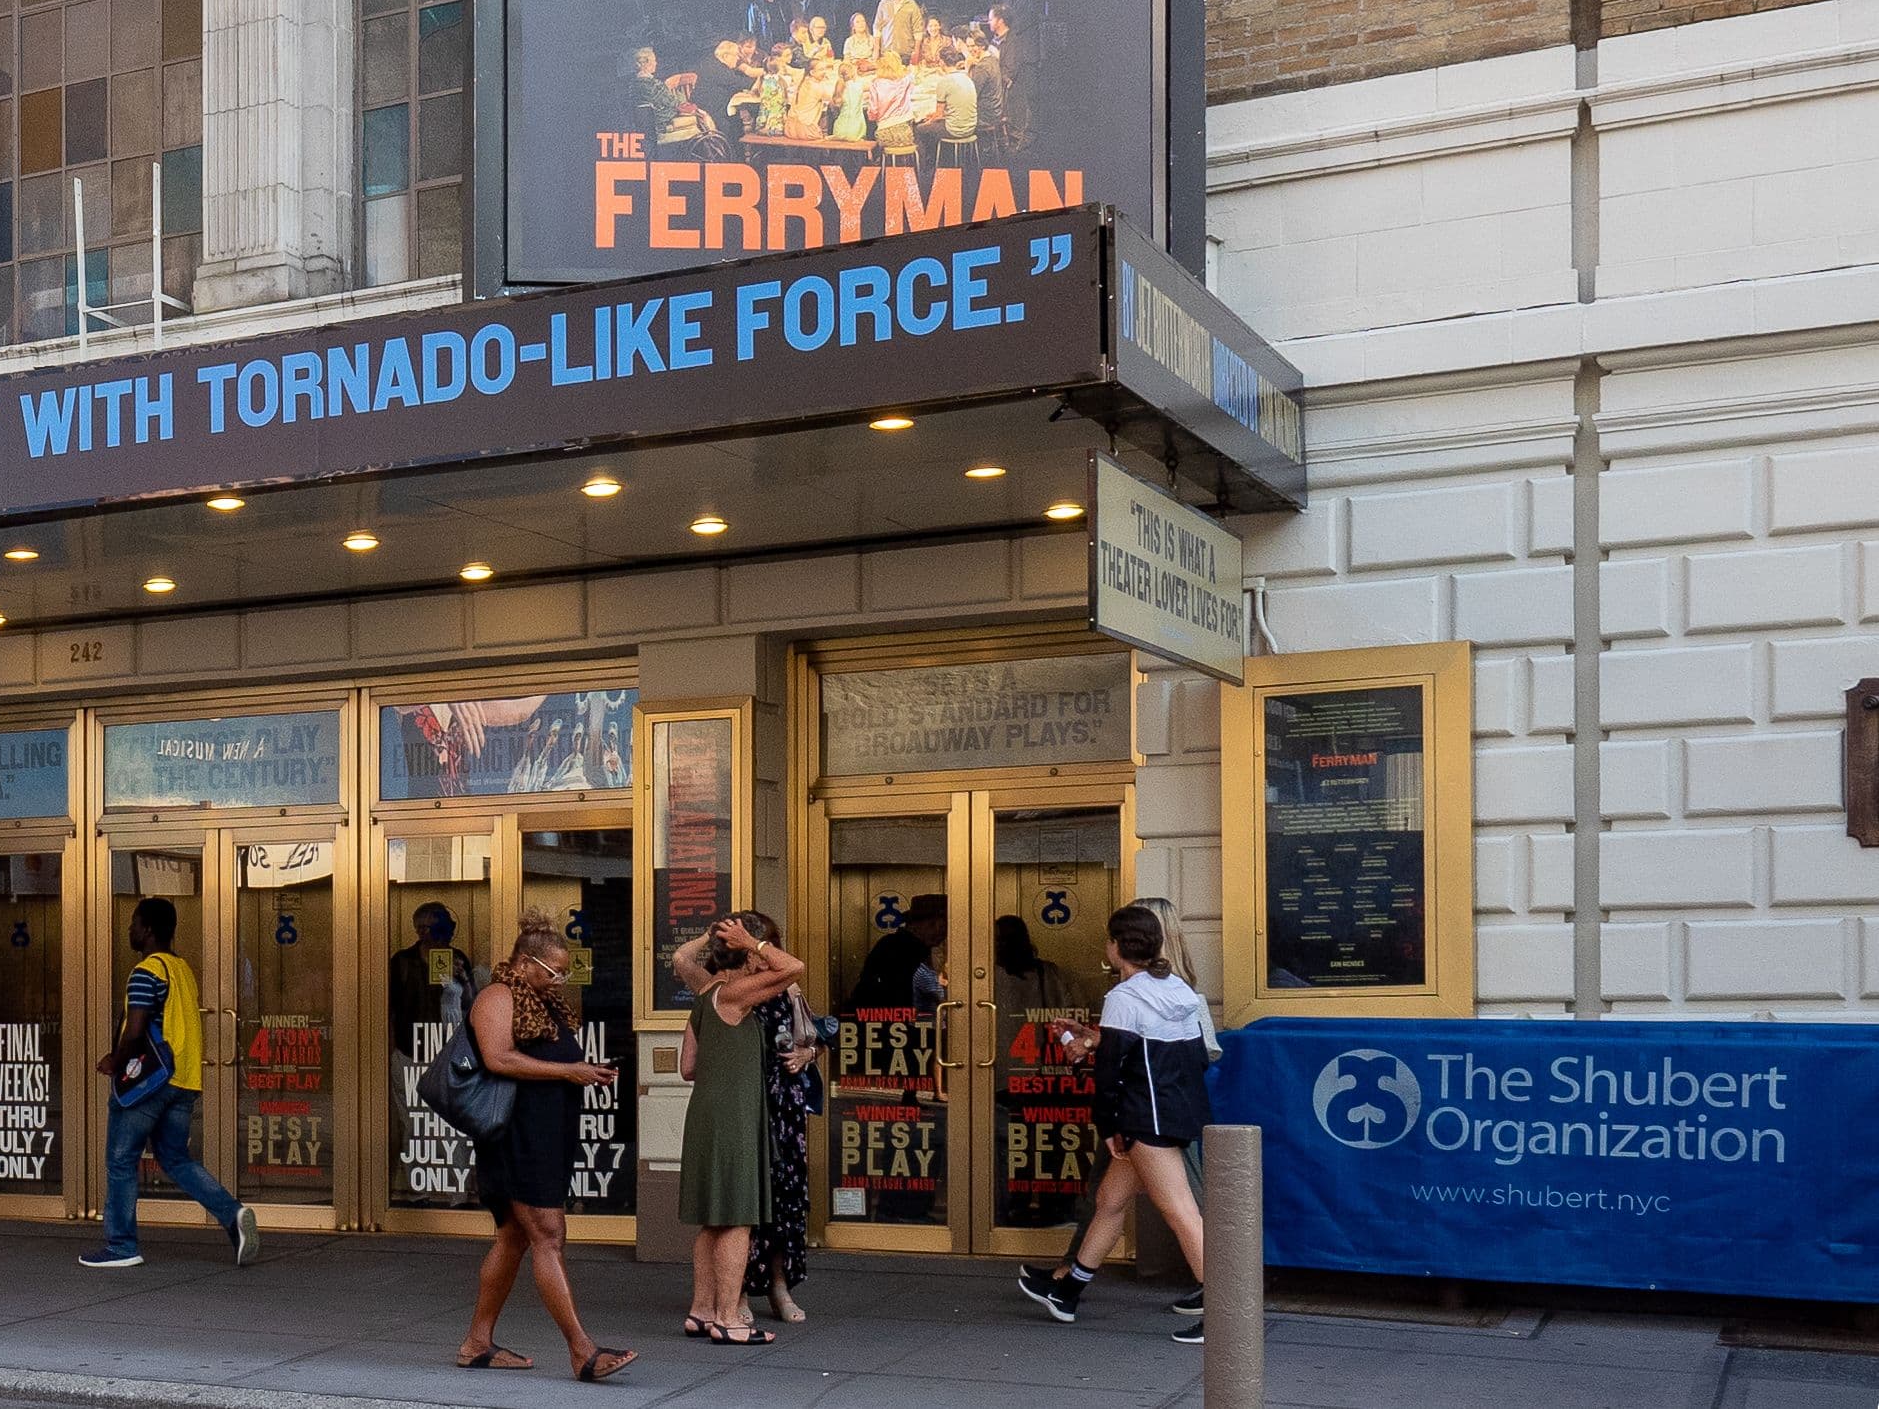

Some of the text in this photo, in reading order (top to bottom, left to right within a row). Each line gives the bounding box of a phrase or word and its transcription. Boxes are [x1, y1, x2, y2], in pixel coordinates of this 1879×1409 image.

[596, 132, 645, 159] THE
[20, 371, 174, 458] WITH
[196, 289, 714, 434] TORNADO-LIKE
[736, 232, 1074, 362] FORCE.”
[1164, 519, 1175, 562] IS
[1178, 526, 1206, 579] WHAT
[1209, 544, 1216, 584] A
[1100, 540, 1151, 605] THEATER
[1154, 566, 1189, 621] LOVER
[1191, 583, 1218, 632] LIVES
[69, 641, 104, 664] 242
[909, 693, 1048, 725] STANDARD
[1057, 688, 1112, 717] FOR
[256, 723, 321, 755] PLAY
[856, 724, 995, 757] BROADWAY
[1311, 752, 1377, 767] FERRYMAN
[153, 761, 201, 794] THE
[261, 1015, 309, 1028] WINNER!
[856, 1008, 917, 1022] WINNER!
[1026, 1008, 1089, 1022] WINNER!
[249, 1029, 271, 1065] 4
[276, 1029, 321, 1046] TONY
[840, 1022, 933, 1049] BEST
[1009, 1024, 1040, 1065] 4
[274, 1046, 321, 1064] AWARDS
[840, 1049, 933, 1076] PLAY
[248, 1073, 321, 1089] BEST PLAY
[1008, 1076, 1095, 1094] BEST PLA
[1427, 1053, 1787, 1111] The Shubert
[856, 1106, 920, 1122] WINNER!
[1023, 1107, 1092, 1123] WINNER!
[248, 1115, 321, 1141] BEST
[842, 1121, 935, 1149] BEST
[1426, 1106, 1786, 1166] Organization
[42, 1131, 54, 1154] 7
[248, 1140, 321, 1166] PLAY
[400, 1140, 458, 1165] JULY
[609, 1144, 625, 1169] 7
[842, 1149, 935, 1177] PLAY
[410, 1168, 470, 1192] ONLY
[1411, 1183, 1672, 1216] www.shubert.nyc
